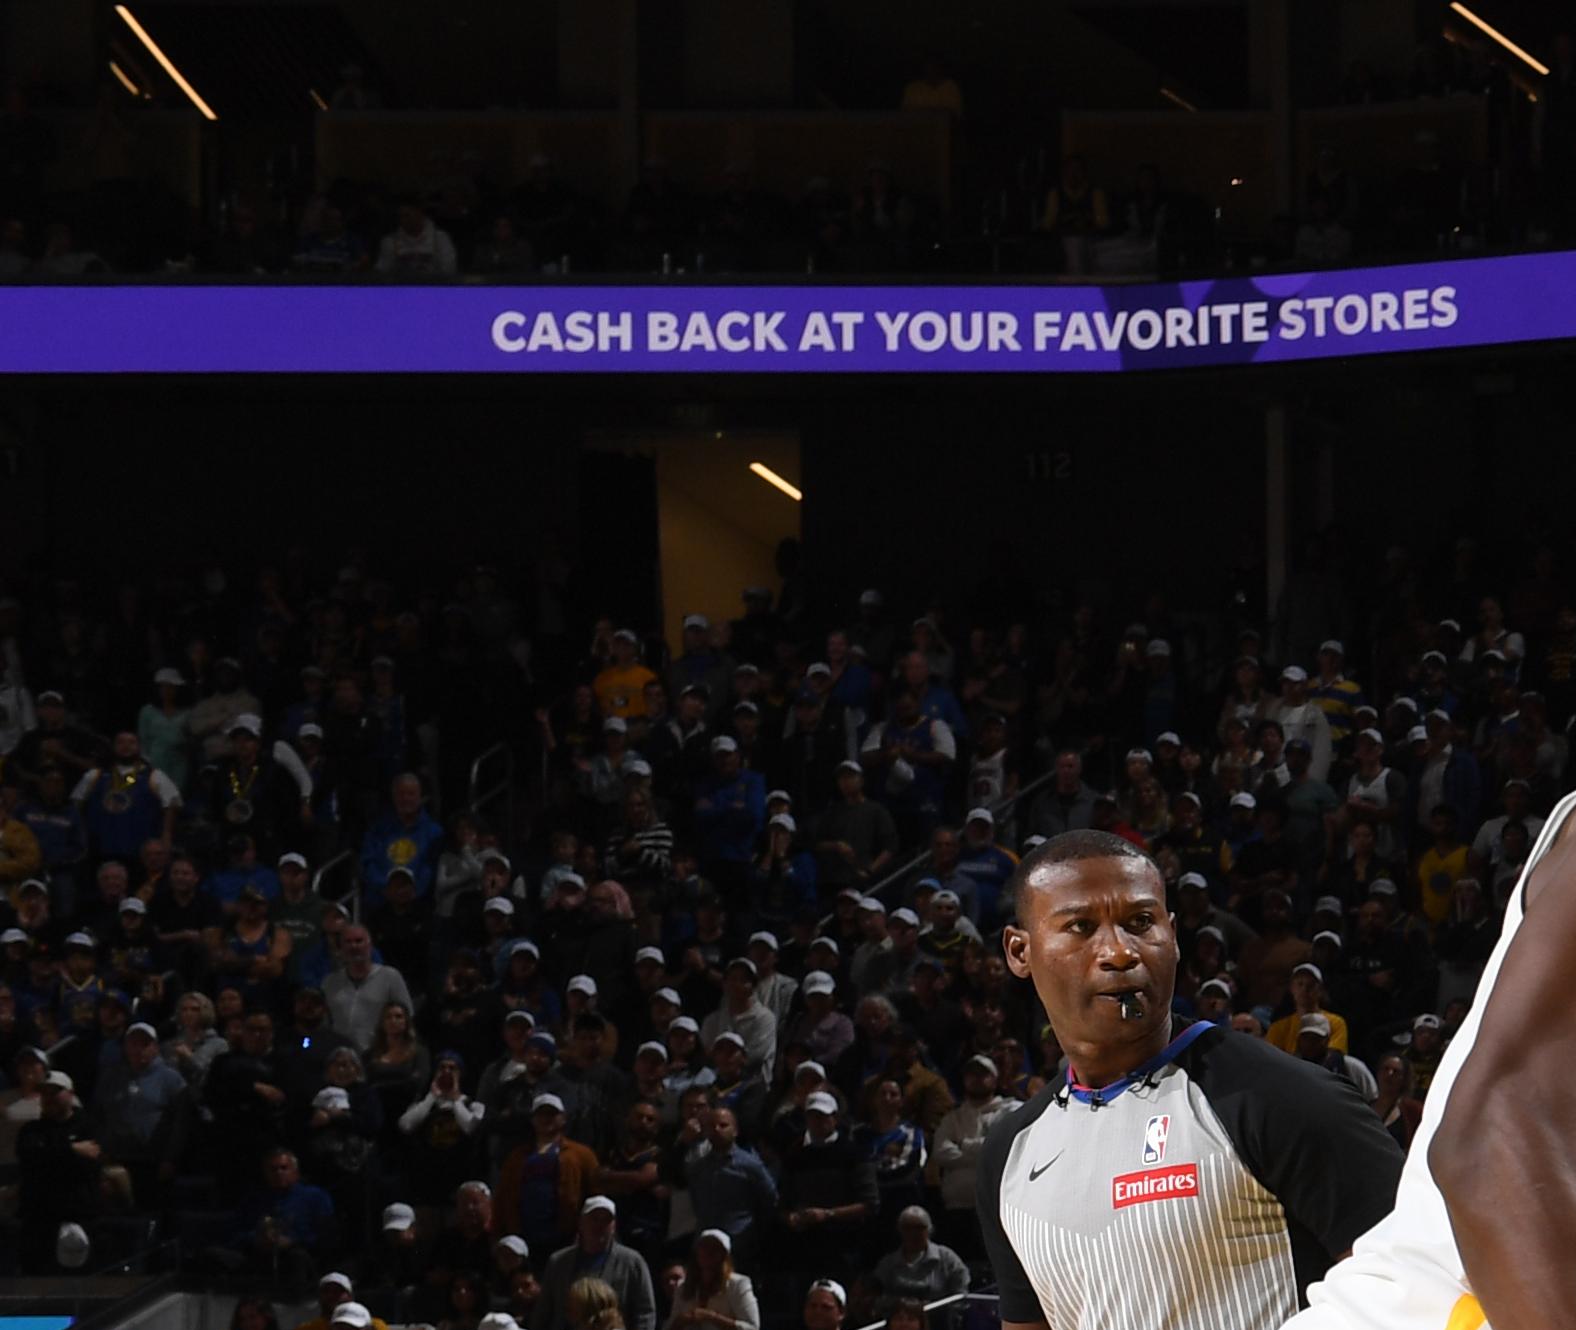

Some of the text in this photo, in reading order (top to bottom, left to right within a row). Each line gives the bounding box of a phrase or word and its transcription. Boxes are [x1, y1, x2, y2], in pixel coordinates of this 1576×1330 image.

[492, 287, 1458, 352] CASH BACK AT YOUR FAVORITE STORES
[1114, 1173, 1196, 1201] Emirates
